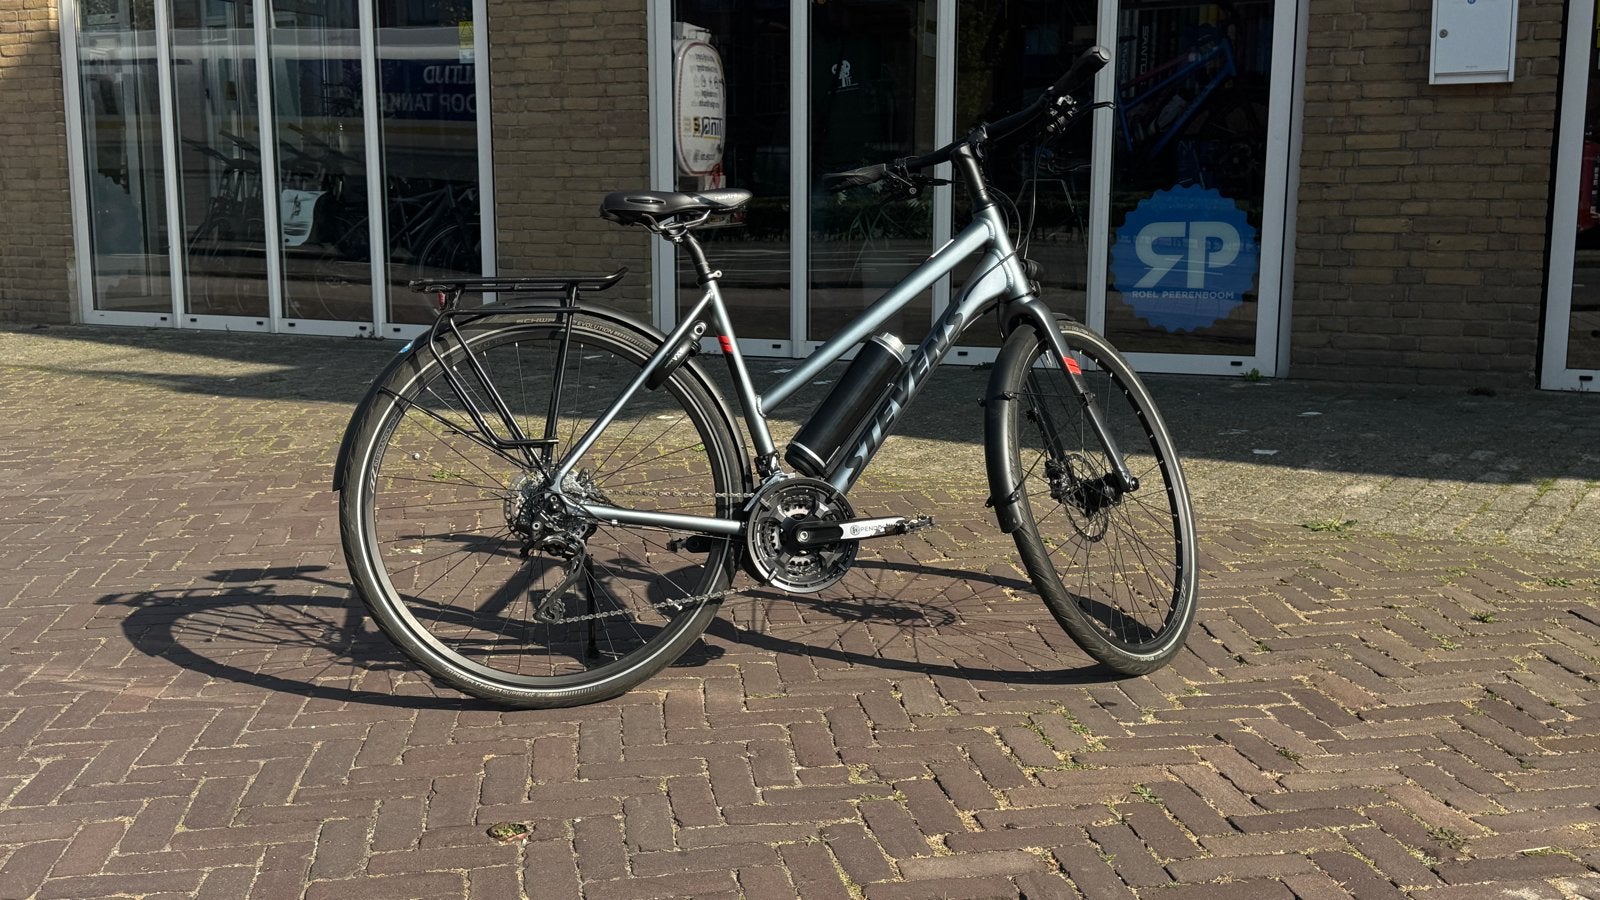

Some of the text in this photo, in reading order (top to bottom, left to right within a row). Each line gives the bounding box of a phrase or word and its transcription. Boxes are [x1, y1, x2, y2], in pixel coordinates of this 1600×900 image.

[1140, 25, 1149, 86] SANTO
[1132, 290, 1234, 299] ROEL PEERENBOOM
[843, 302, 964, 485] STEVENS
[502, 689, 536, 698] SUPREME
